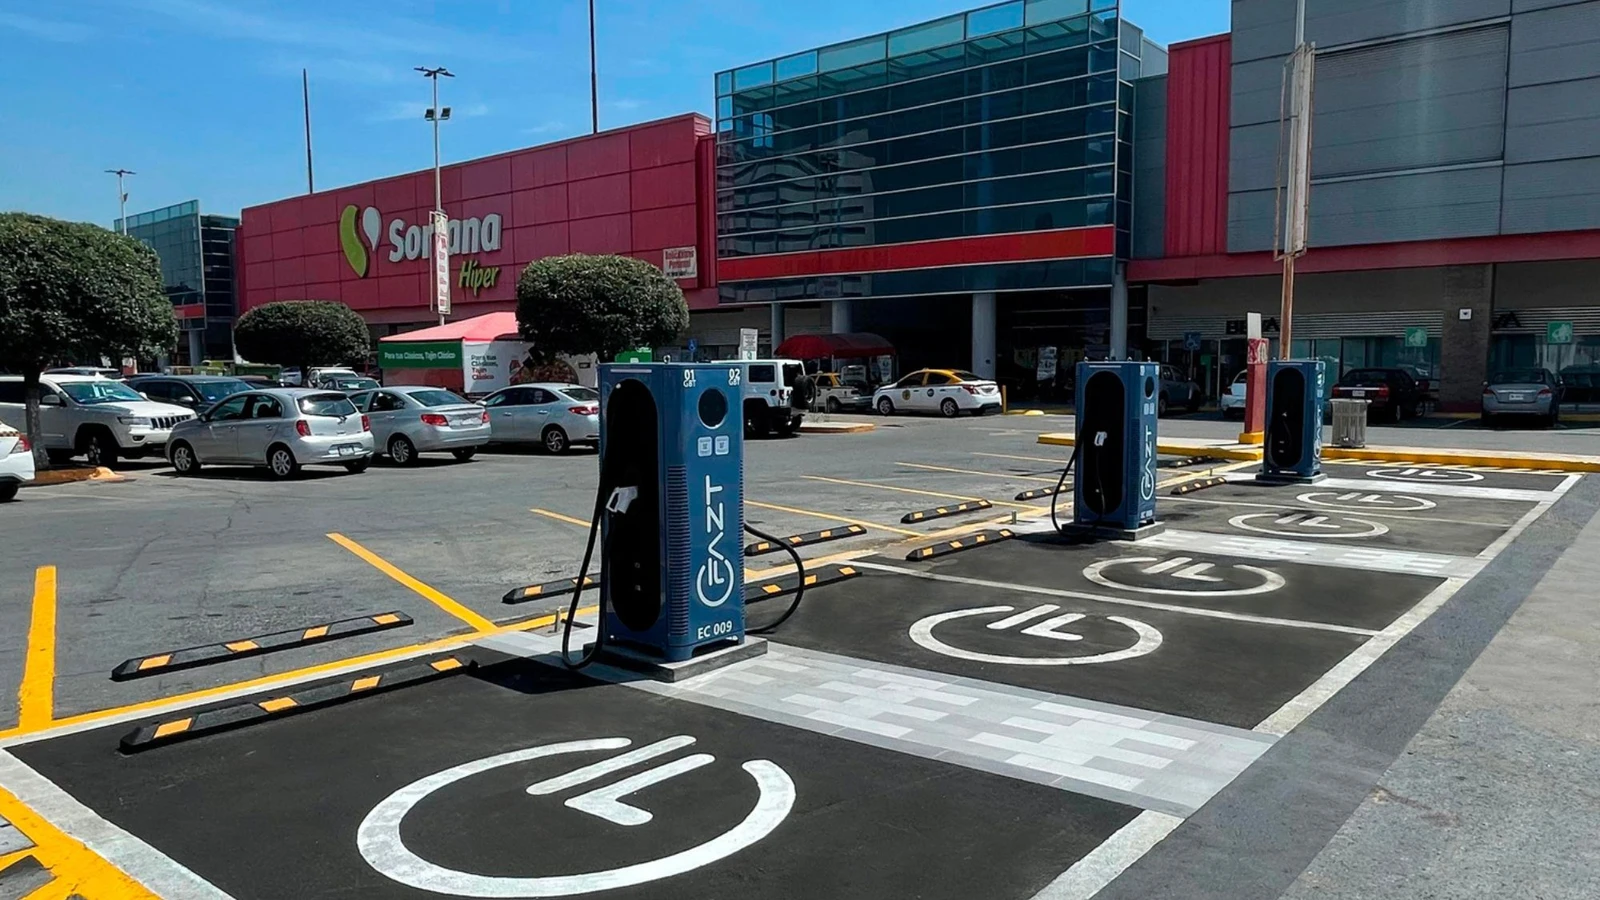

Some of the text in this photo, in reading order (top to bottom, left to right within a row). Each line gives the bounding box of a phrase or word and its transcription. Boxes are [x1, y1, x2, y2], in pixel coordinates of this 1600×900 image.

[389, 213, 502, 263] Sorana
[458, 260, 500, 296] Híper
[684, 369, 695, 381] 01
[728, 368, 740, 380] 02
[683, 380, 696, 388] GBT
[697, 620, 733, 640] EC 009
